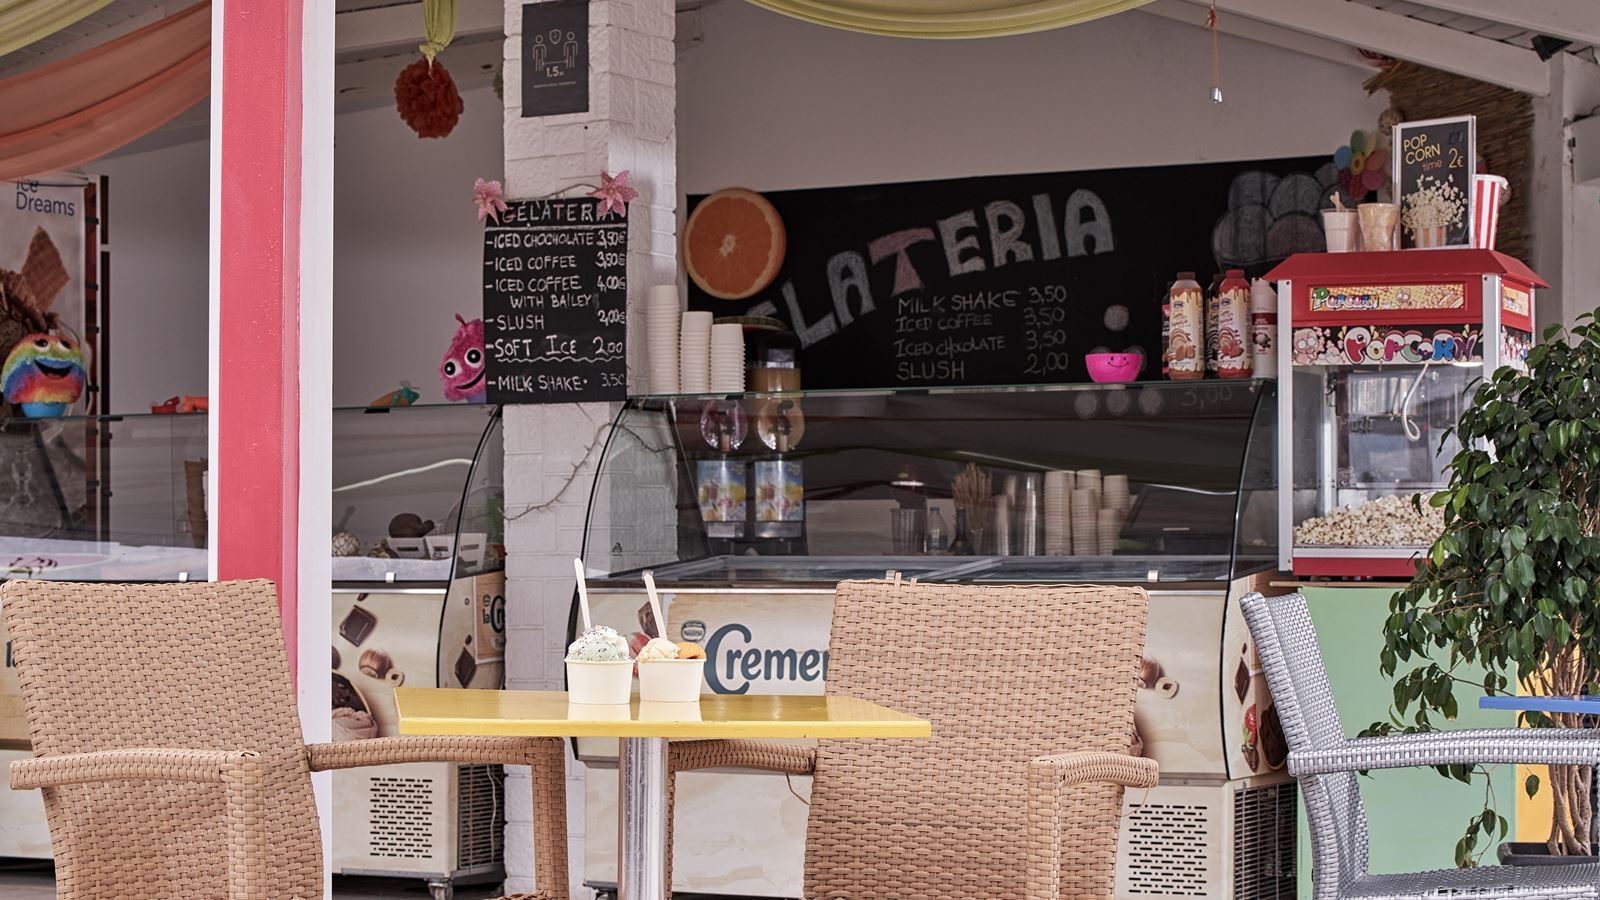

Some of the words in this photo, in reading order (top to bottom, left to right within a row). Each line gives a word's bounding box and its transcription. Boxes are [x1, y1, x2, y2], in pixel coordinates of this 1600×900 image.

[1403, 134, 1427, 152] POP
[1406, 144, 1441, 165] CORN
[1448, 148, 1464, 168] 2€
[16, 191, 75, 216] Dreams
[524, 232, 594, 248] CHOCHOLATE
[528, 255, 577, 270] COFFEE
[746, 189, 1115, 350] LATERIA
[528, 275, 582, 292] COFFEE
[510, 295, 545, 309] WITH
[551, 293, 592, 308] BAILEY
[898, 296, 946, 315] MILK
[951, 290, 1021, 311] SHAKE
[1028, 285, 1067, 304] 3,50
[895, 315, 933, 333] ICED
[937, 312, 993, 330] COFFEE
[1023, 307, 1065, 328] 3,50
[894, 339, 933, 358] ICED
[1025, 329, 1067, 350] 3,50
[896, 361, 965, 380] SLUSH
[1024, 352, 1069, 375] 2,00
